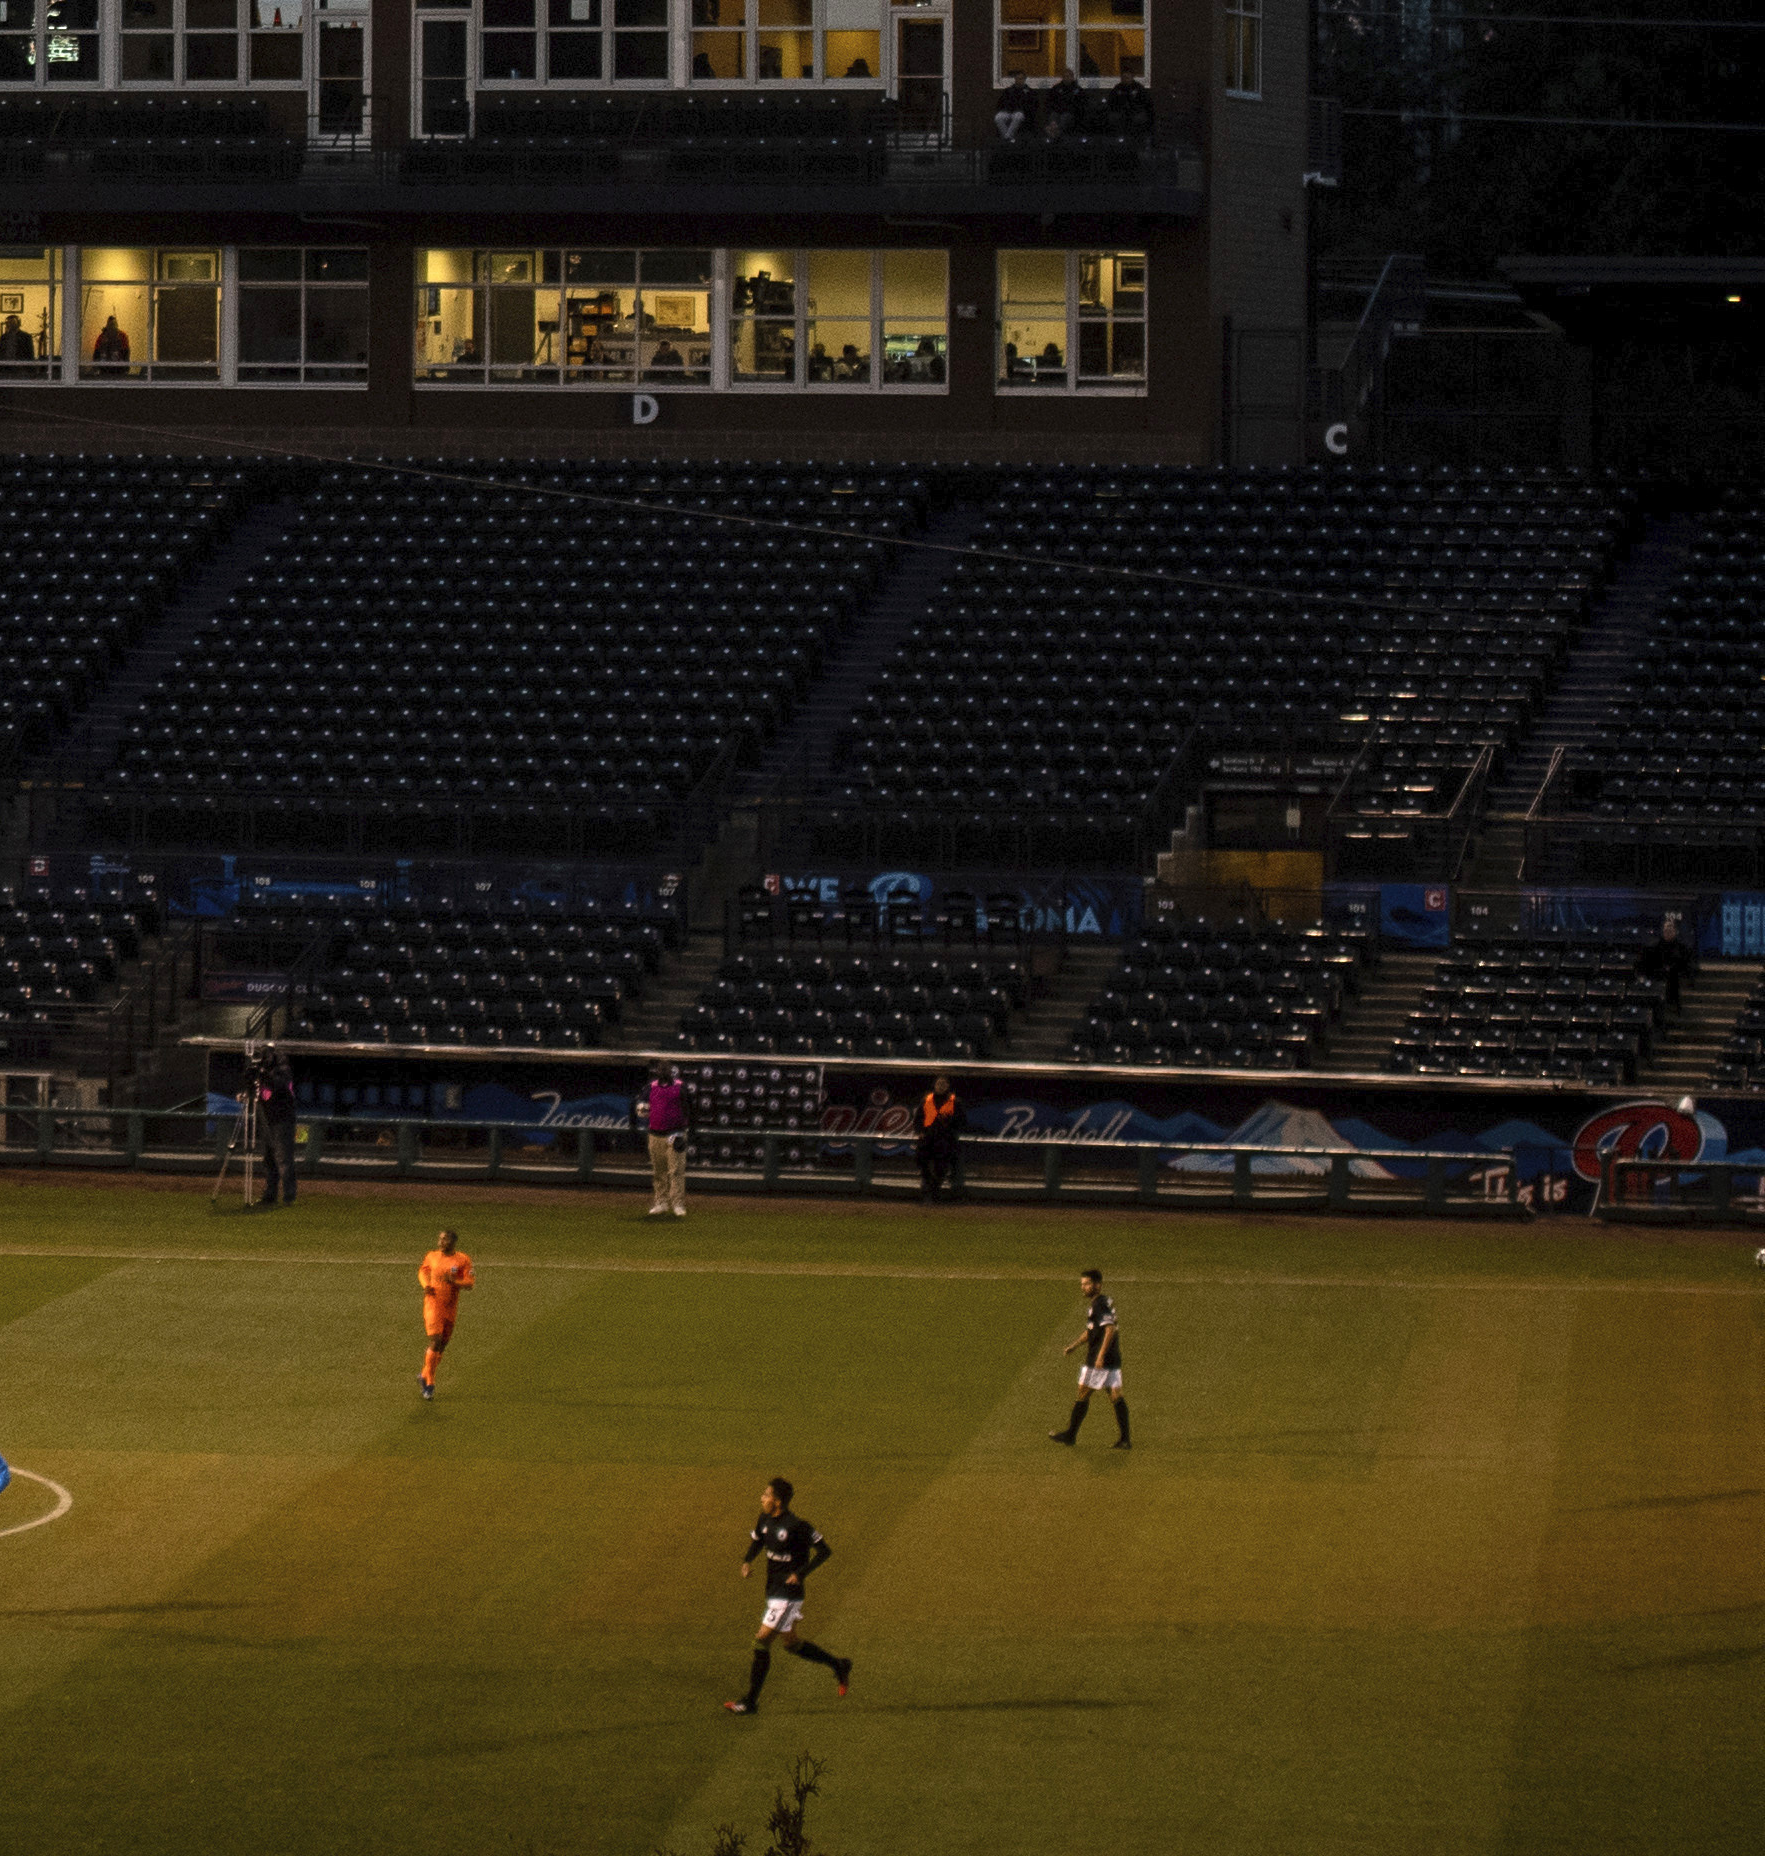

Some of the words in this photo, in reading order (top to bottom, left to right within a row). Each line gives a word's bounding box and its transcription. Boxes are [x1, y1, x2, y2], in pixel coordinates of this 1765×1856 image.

[632, 394, 659, 425] D
[1324, 423, 1348, 455] C
[783, 876, 839, 902] WE
[531, 1091, 630, 1129] Tacoma
[997, 1106, 1133, 1143] Baseball
